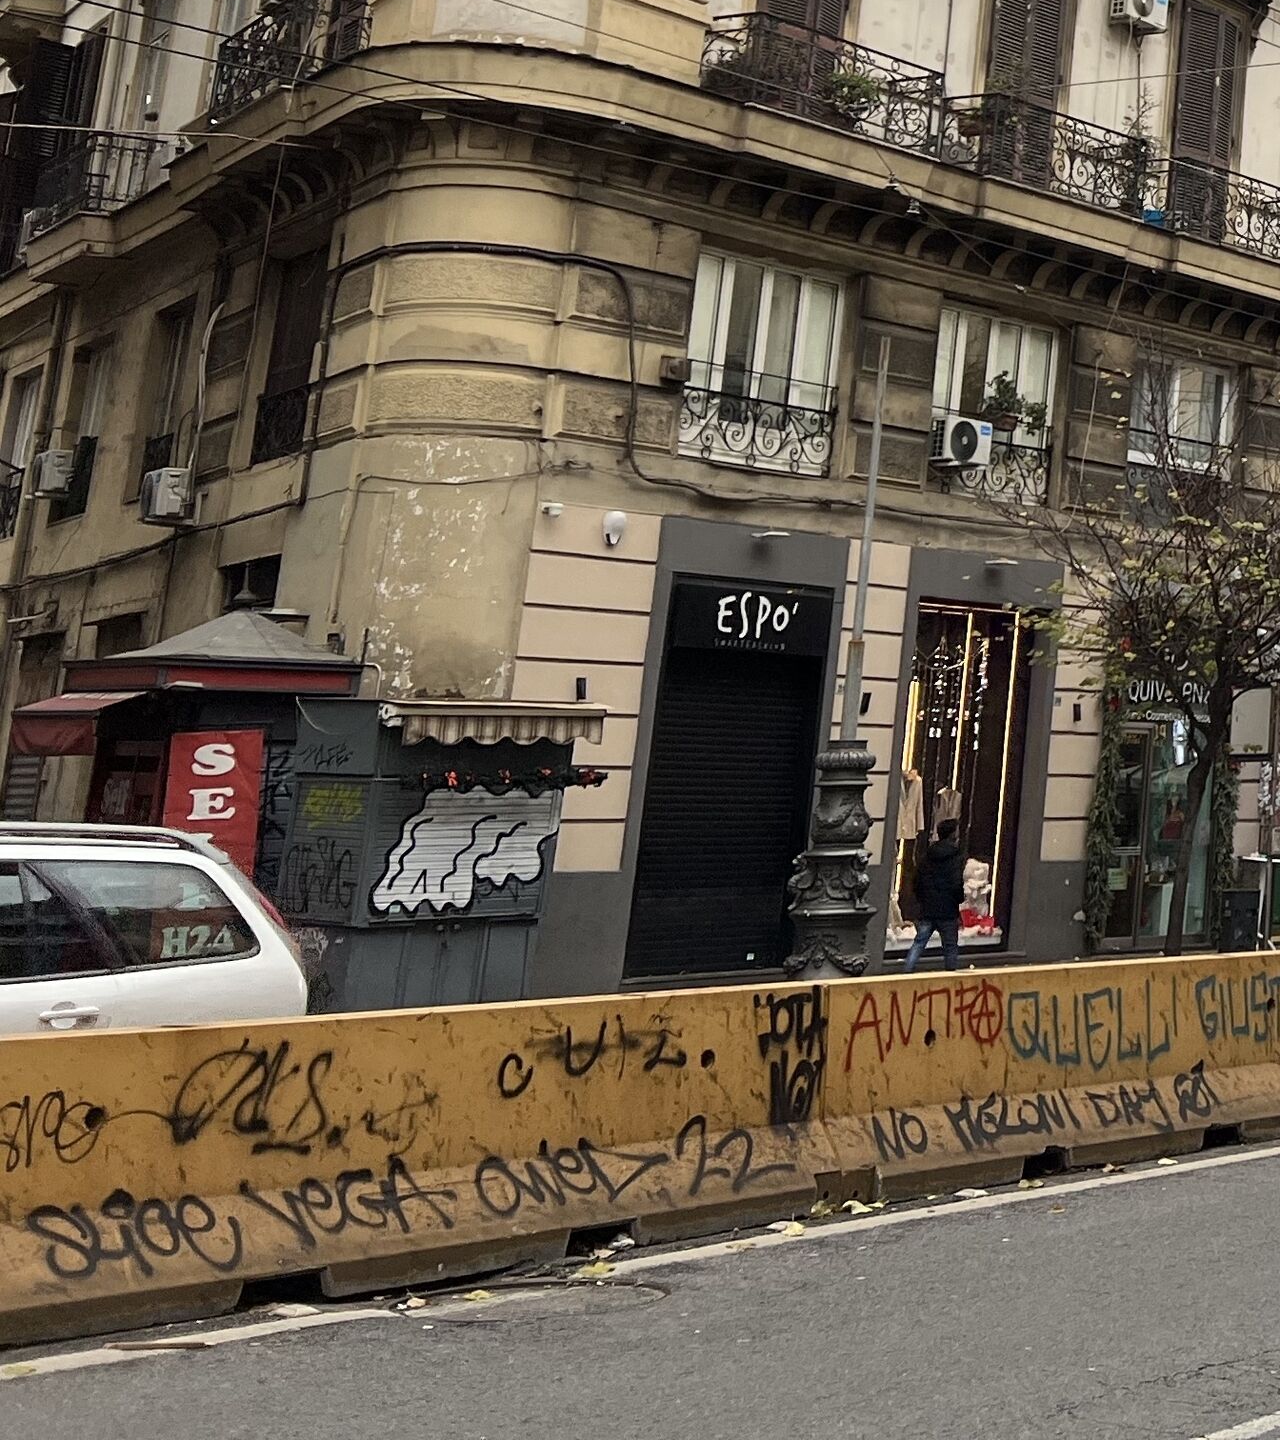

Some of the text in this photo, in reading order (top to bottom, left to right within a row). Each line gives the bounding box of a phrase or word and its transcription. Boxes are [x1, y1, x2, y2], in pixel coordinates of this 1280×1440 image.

[159, 925, 235, 959] H24
[1007, 975, 1177, 1070] QUELLI
[872, 1107, 928, 1161] NO
[943, 1089, 1081, 1154] MELONI
[1085, 1079, 1175, 1134] DAY
